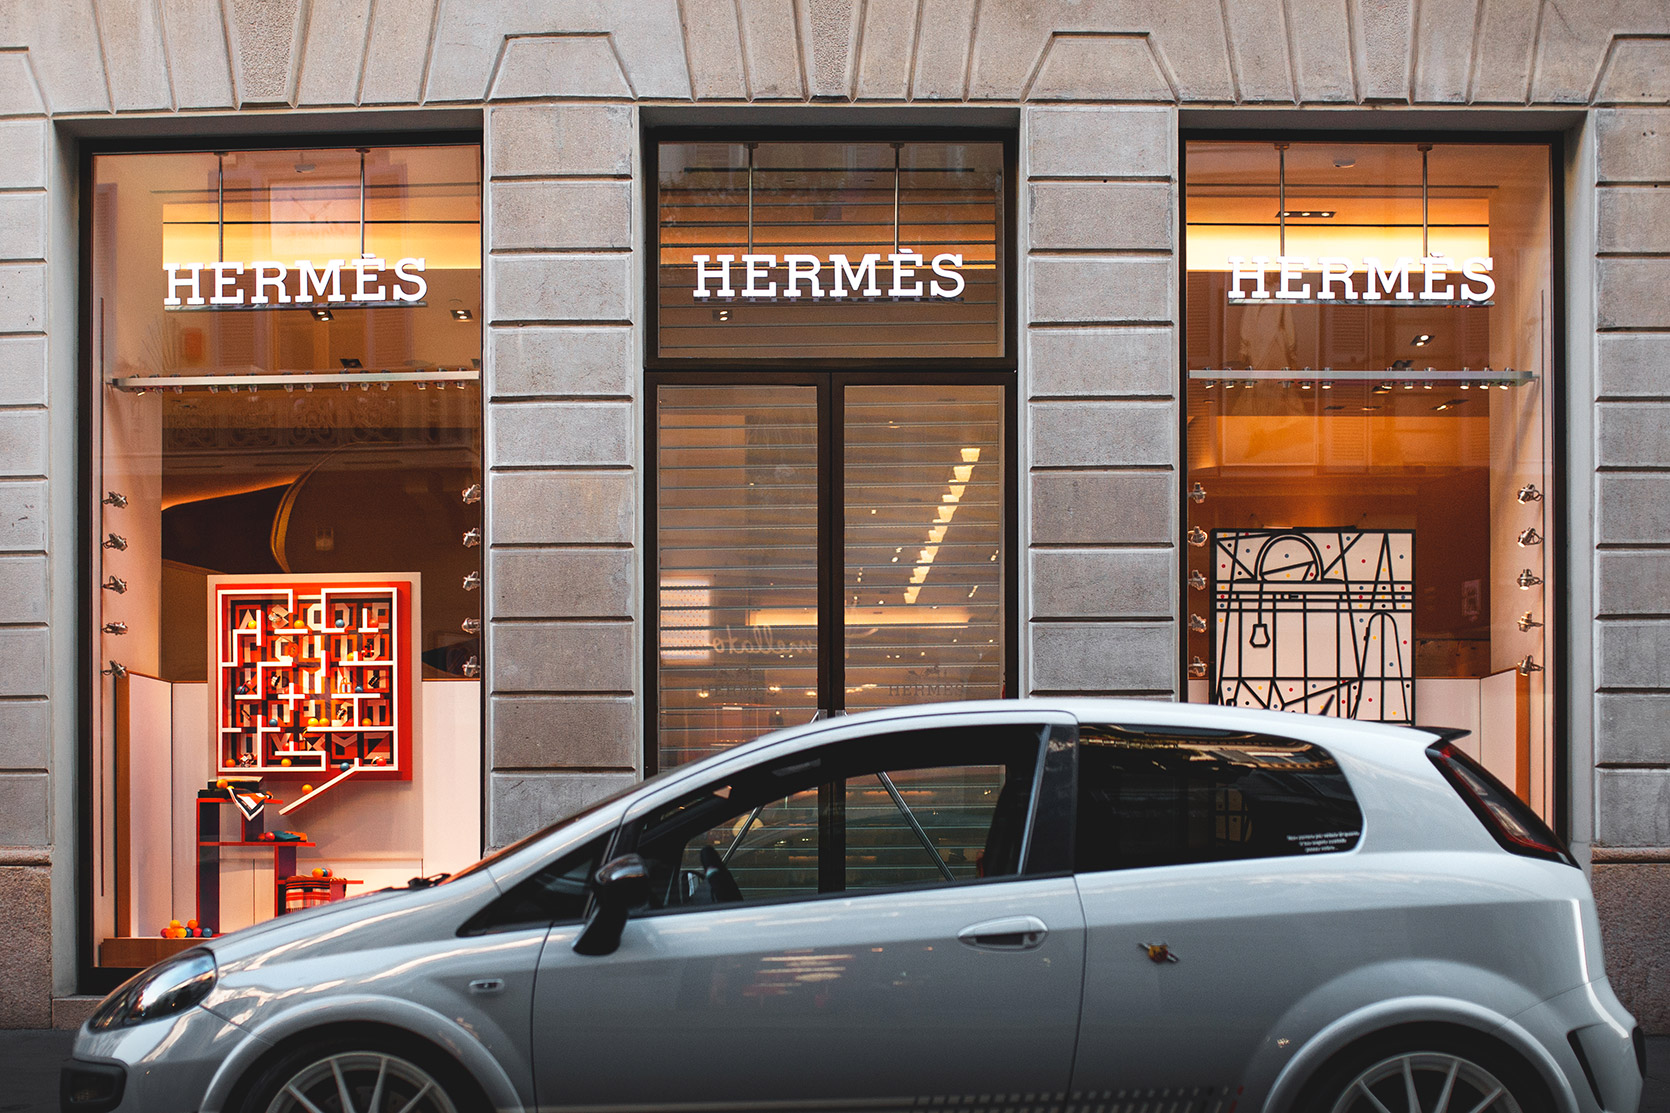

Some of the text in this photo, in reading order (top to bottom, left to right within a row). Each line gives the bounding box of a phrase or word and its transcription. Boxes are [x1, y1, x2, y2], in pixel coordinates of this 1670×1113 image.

[163, 253, 428, 305] HERMÈS
[692, 248, 966, 298] HERMÈS
[1227, 251, 1496, 301] HERMÈS
